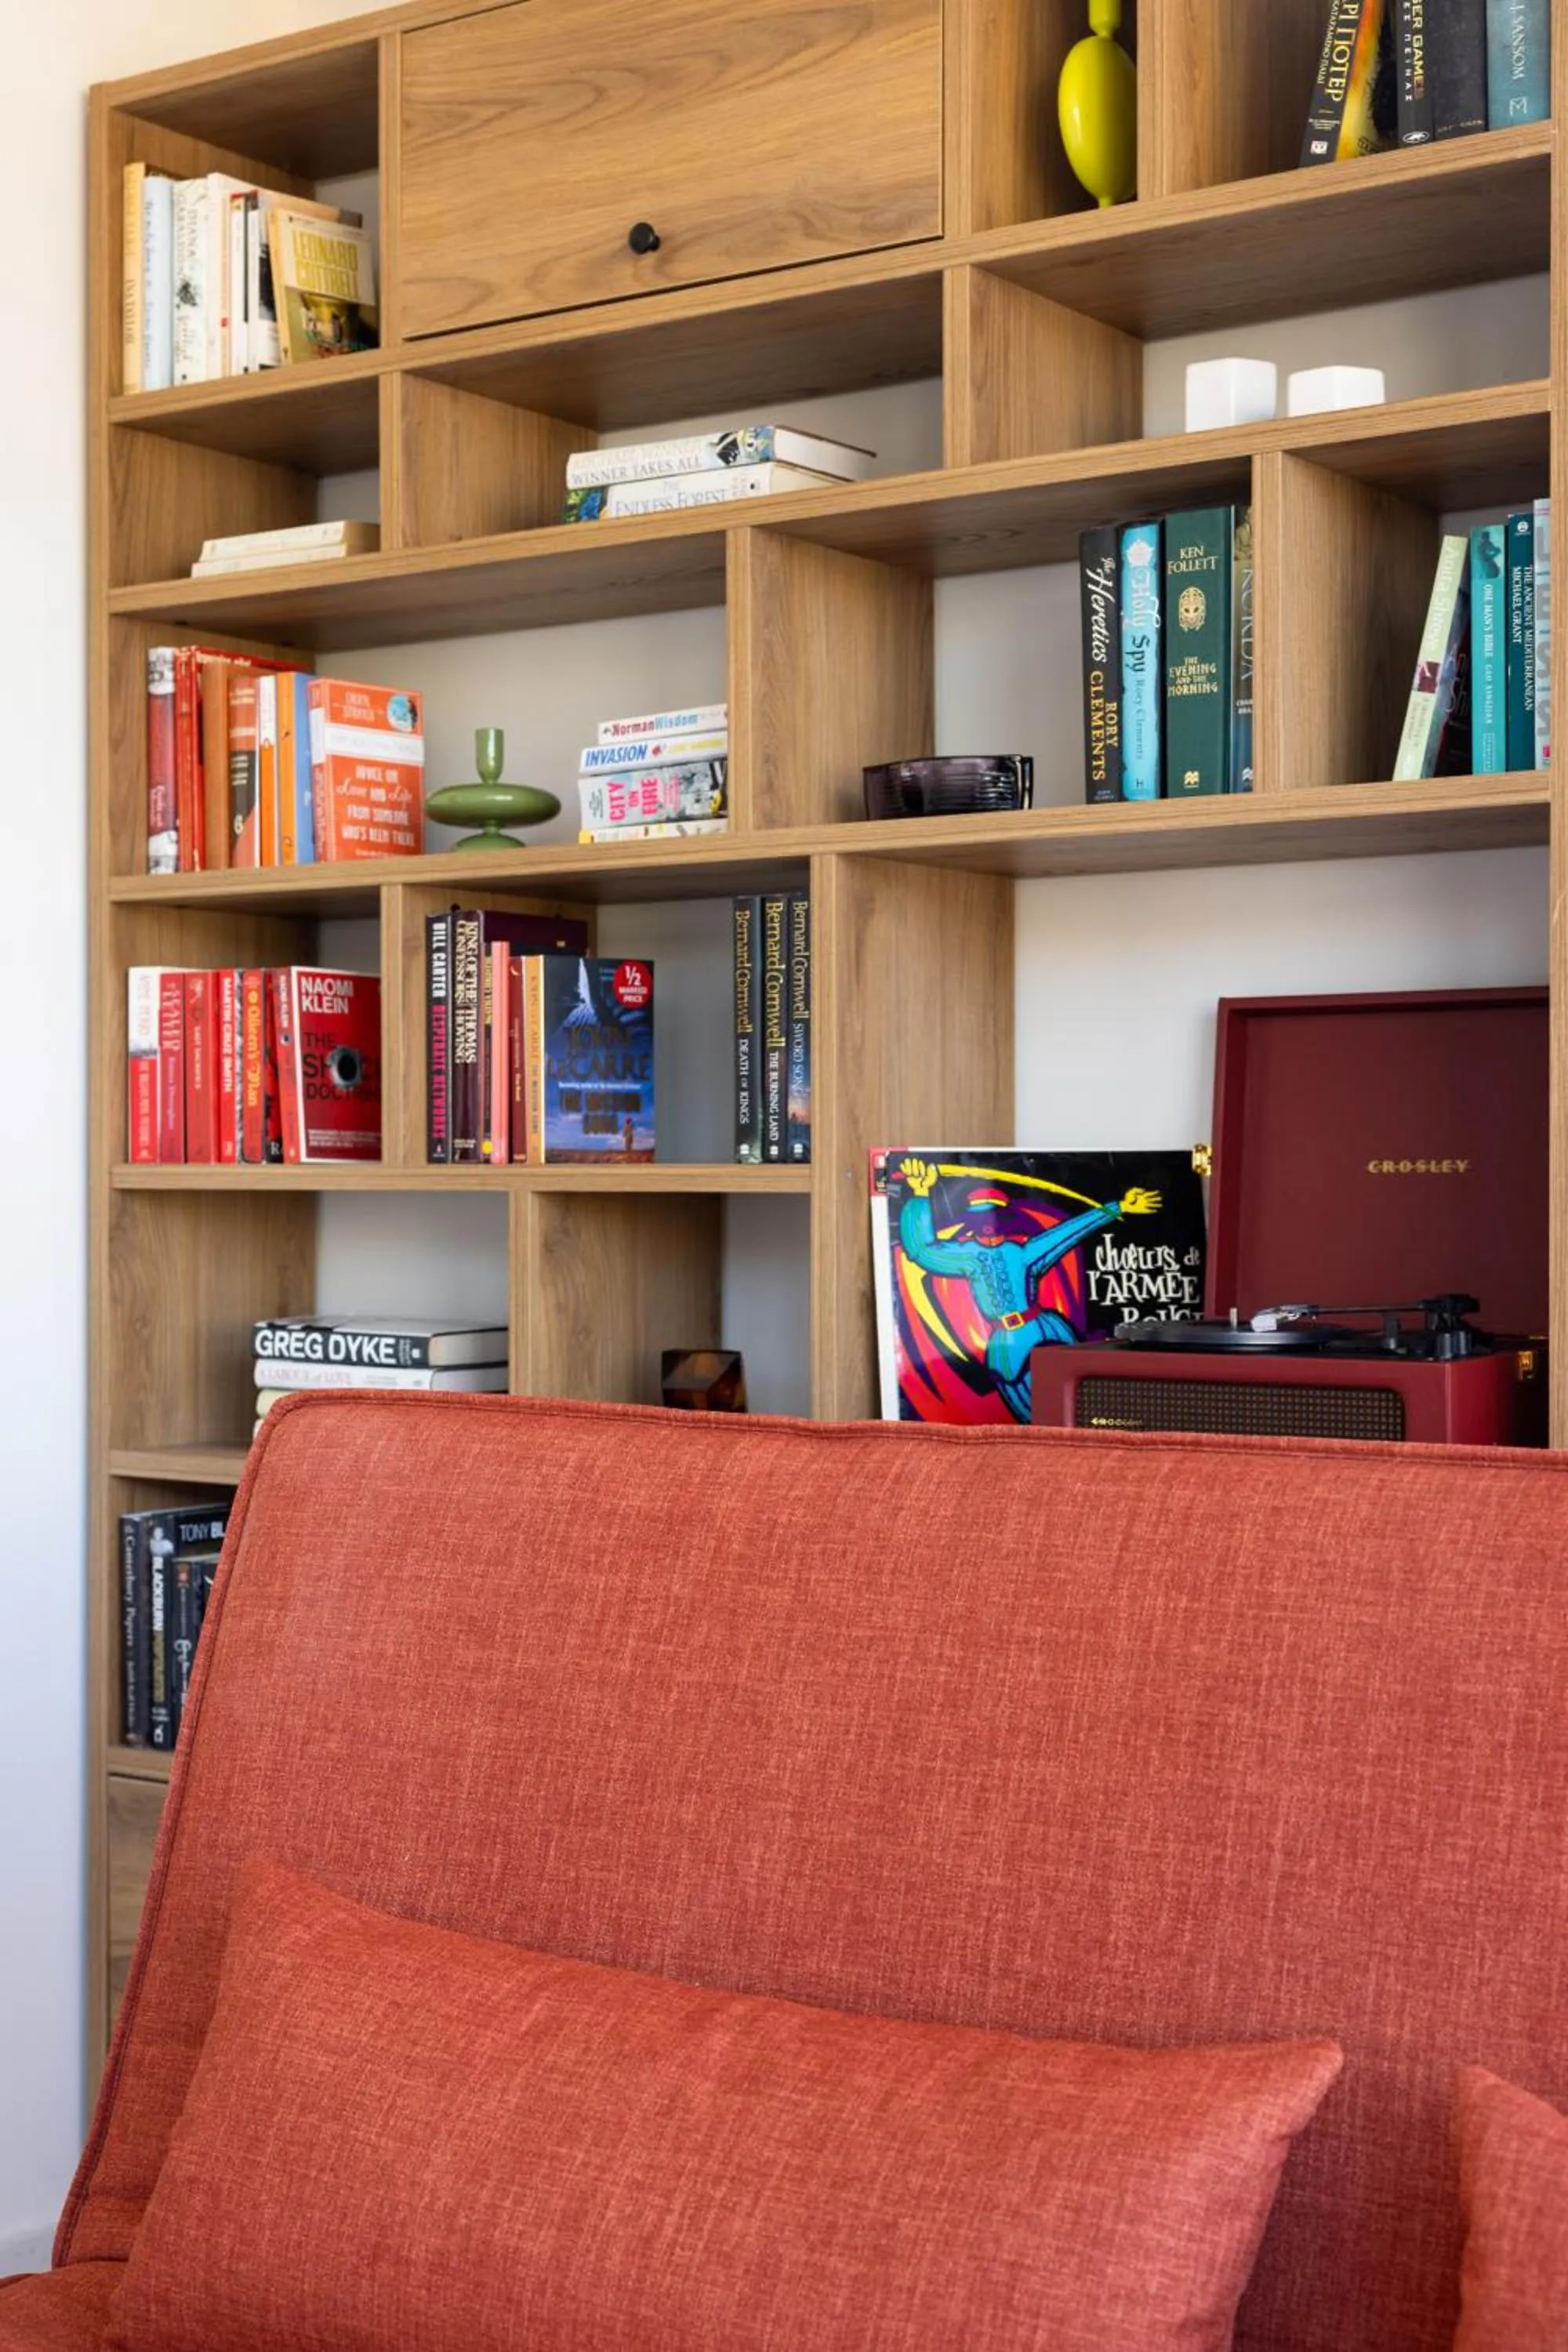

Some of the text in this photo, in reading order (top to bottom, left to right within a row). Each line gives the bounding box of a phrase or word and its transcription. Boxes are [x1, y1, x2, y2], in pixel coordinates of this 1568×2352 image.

[1511, 16, 1526, 80] SANSOM
[572, 456, 702, 485] WINNER TAKES ALL
[677, 488, 726, 509] FOREST
[1167, 555, 1221, 575] FOLLETT
[1179, 545, 1205, 560] KEN
[1086, 568, 1116, 663] Heretics
[1512, 565, 1523, 644] MICHAEL GRANT
[1123, 633, 1150, 673] Spy
[1169, 662, 1218, 677] EVENING
[1167, 682, 1219, 698] MORNING
[1088, 670, 1106, 781] CLEMENTS
[1105, 702, 1119, 748] RORY
[1134, 709, 1148, 760] Clements
[585, 745, 648, 768] INVASION
[608, 780, 626, 822] CITY
[641, 777, 659, 816] FIRE
[466, 921, 478, 953] KING
[735, 909, 753, 1033] Bernard Cornwell
[765, 902, 786, 1047] Bernard Cornwell
[792, 901, 810, 1019] Bernard Cornwell
[301, 976, 354, 997] NAOMI
[302, 995, 350, 1014] KLEIN
[223, 977, 233, 1092] MARTIN CRUZ SMITH
[247, 1004, 261, 1060] Queen's
[432, 922, 446, 1139] BILL CARTER DESPERATE NETWORKS
[465, 1007, 477, 1063] THOMAS
[793, 1023, 804, 1062] SWORD
[739, 1039, 750, 1076] DEATH
[769, 1051, 779, 1069] THE
[739, 1091, 750, 1124] KINGS
[769, 1115, 779, 1141] LAND
[1368, 1159, 1468, 1174] CROSLEY
[255, 1329, 324, 1360] GREG
[328, 1331, 397, 1365] DYKE
[180, 1525, 211, 1542] TONY
[123, 1536, 136, 1603] Canterbury
[151, 1556, 164, 1632] BLACKBURN
